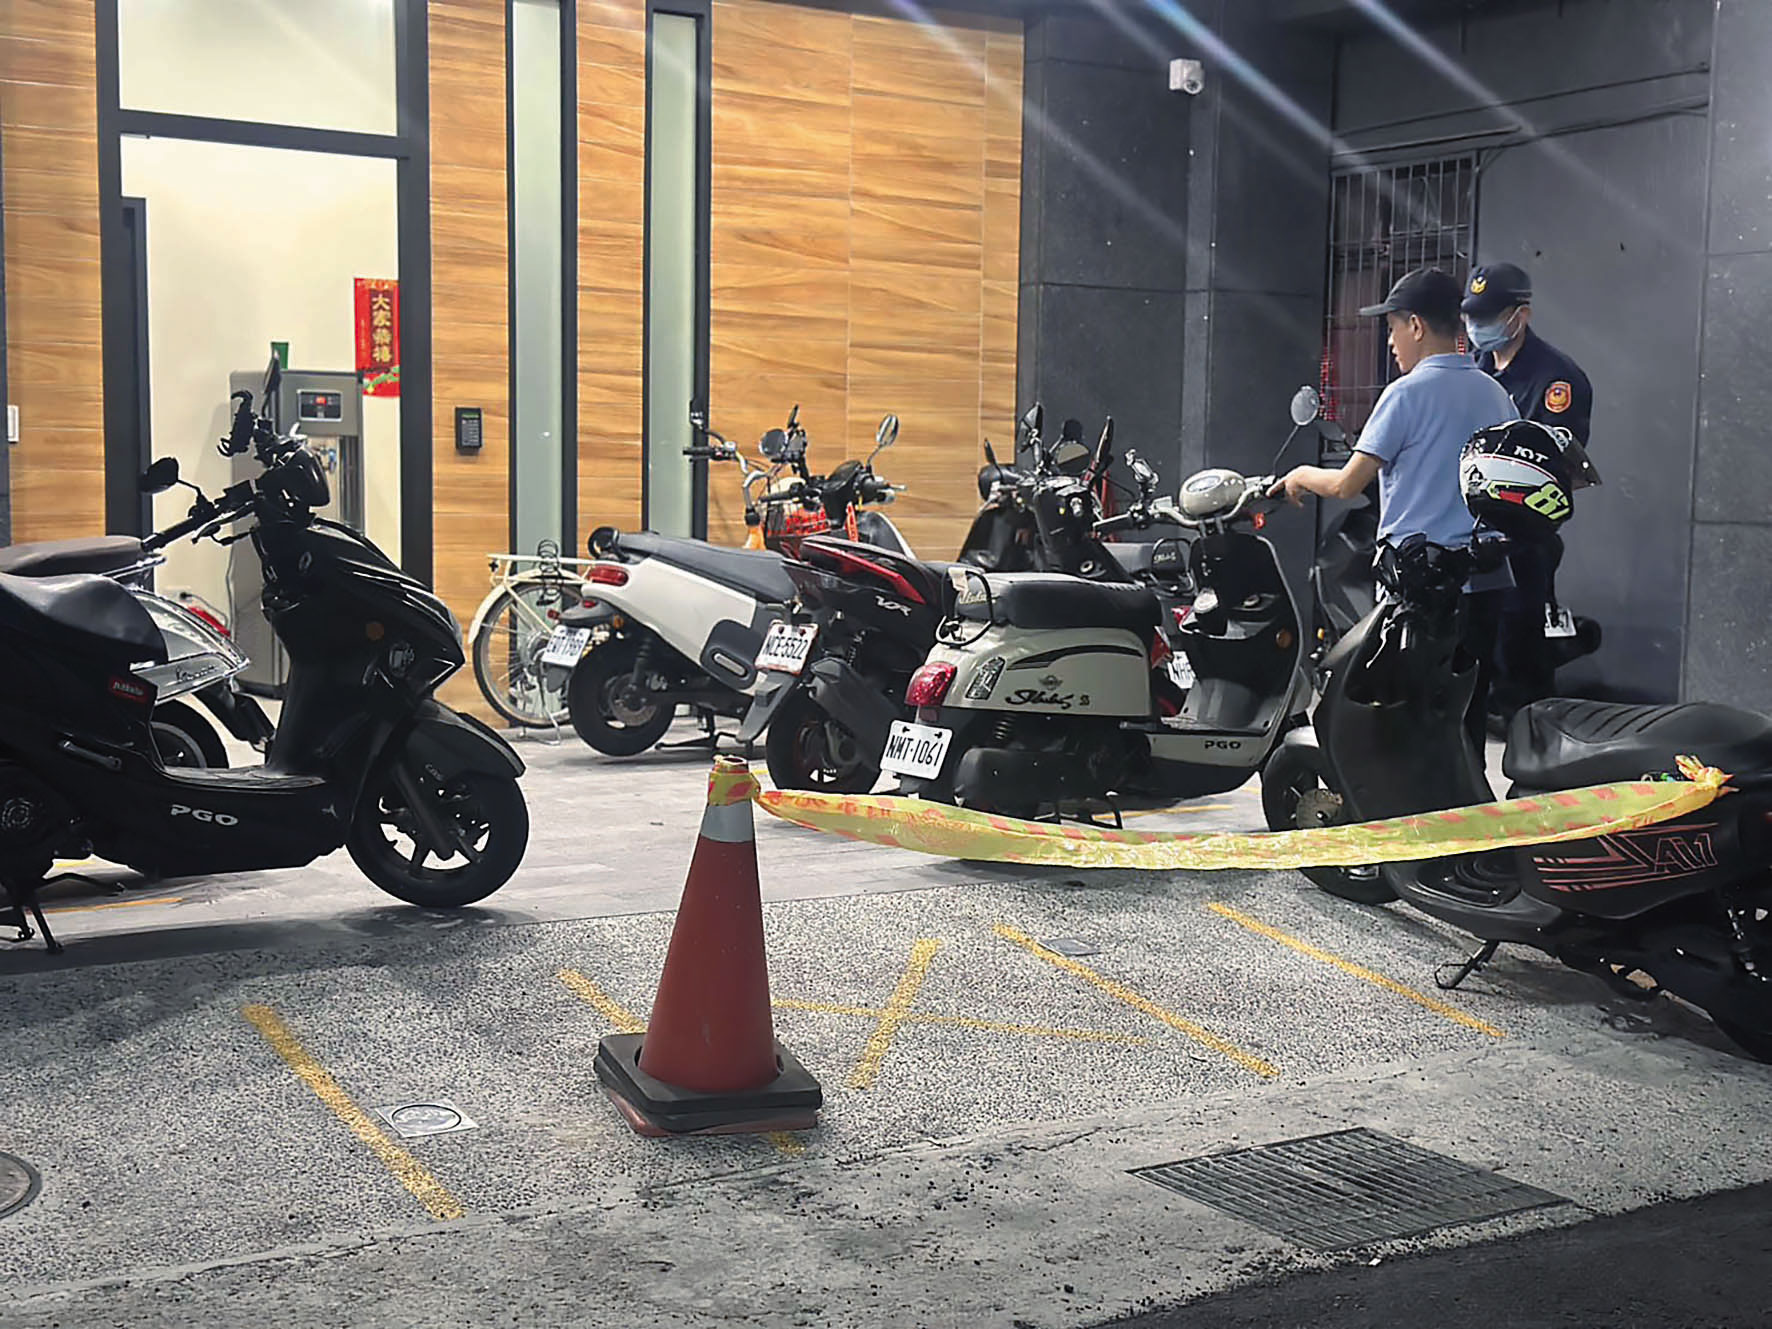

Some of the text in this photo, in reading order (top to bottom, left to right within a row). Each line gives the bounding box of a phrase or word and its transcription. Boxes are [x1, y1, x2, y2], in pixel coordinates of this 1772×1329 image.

[886, 734, 944, 767] NMT-1061
[1204, 740, 1242, 750] PGO
[170, 804, 239, 826] PGO
